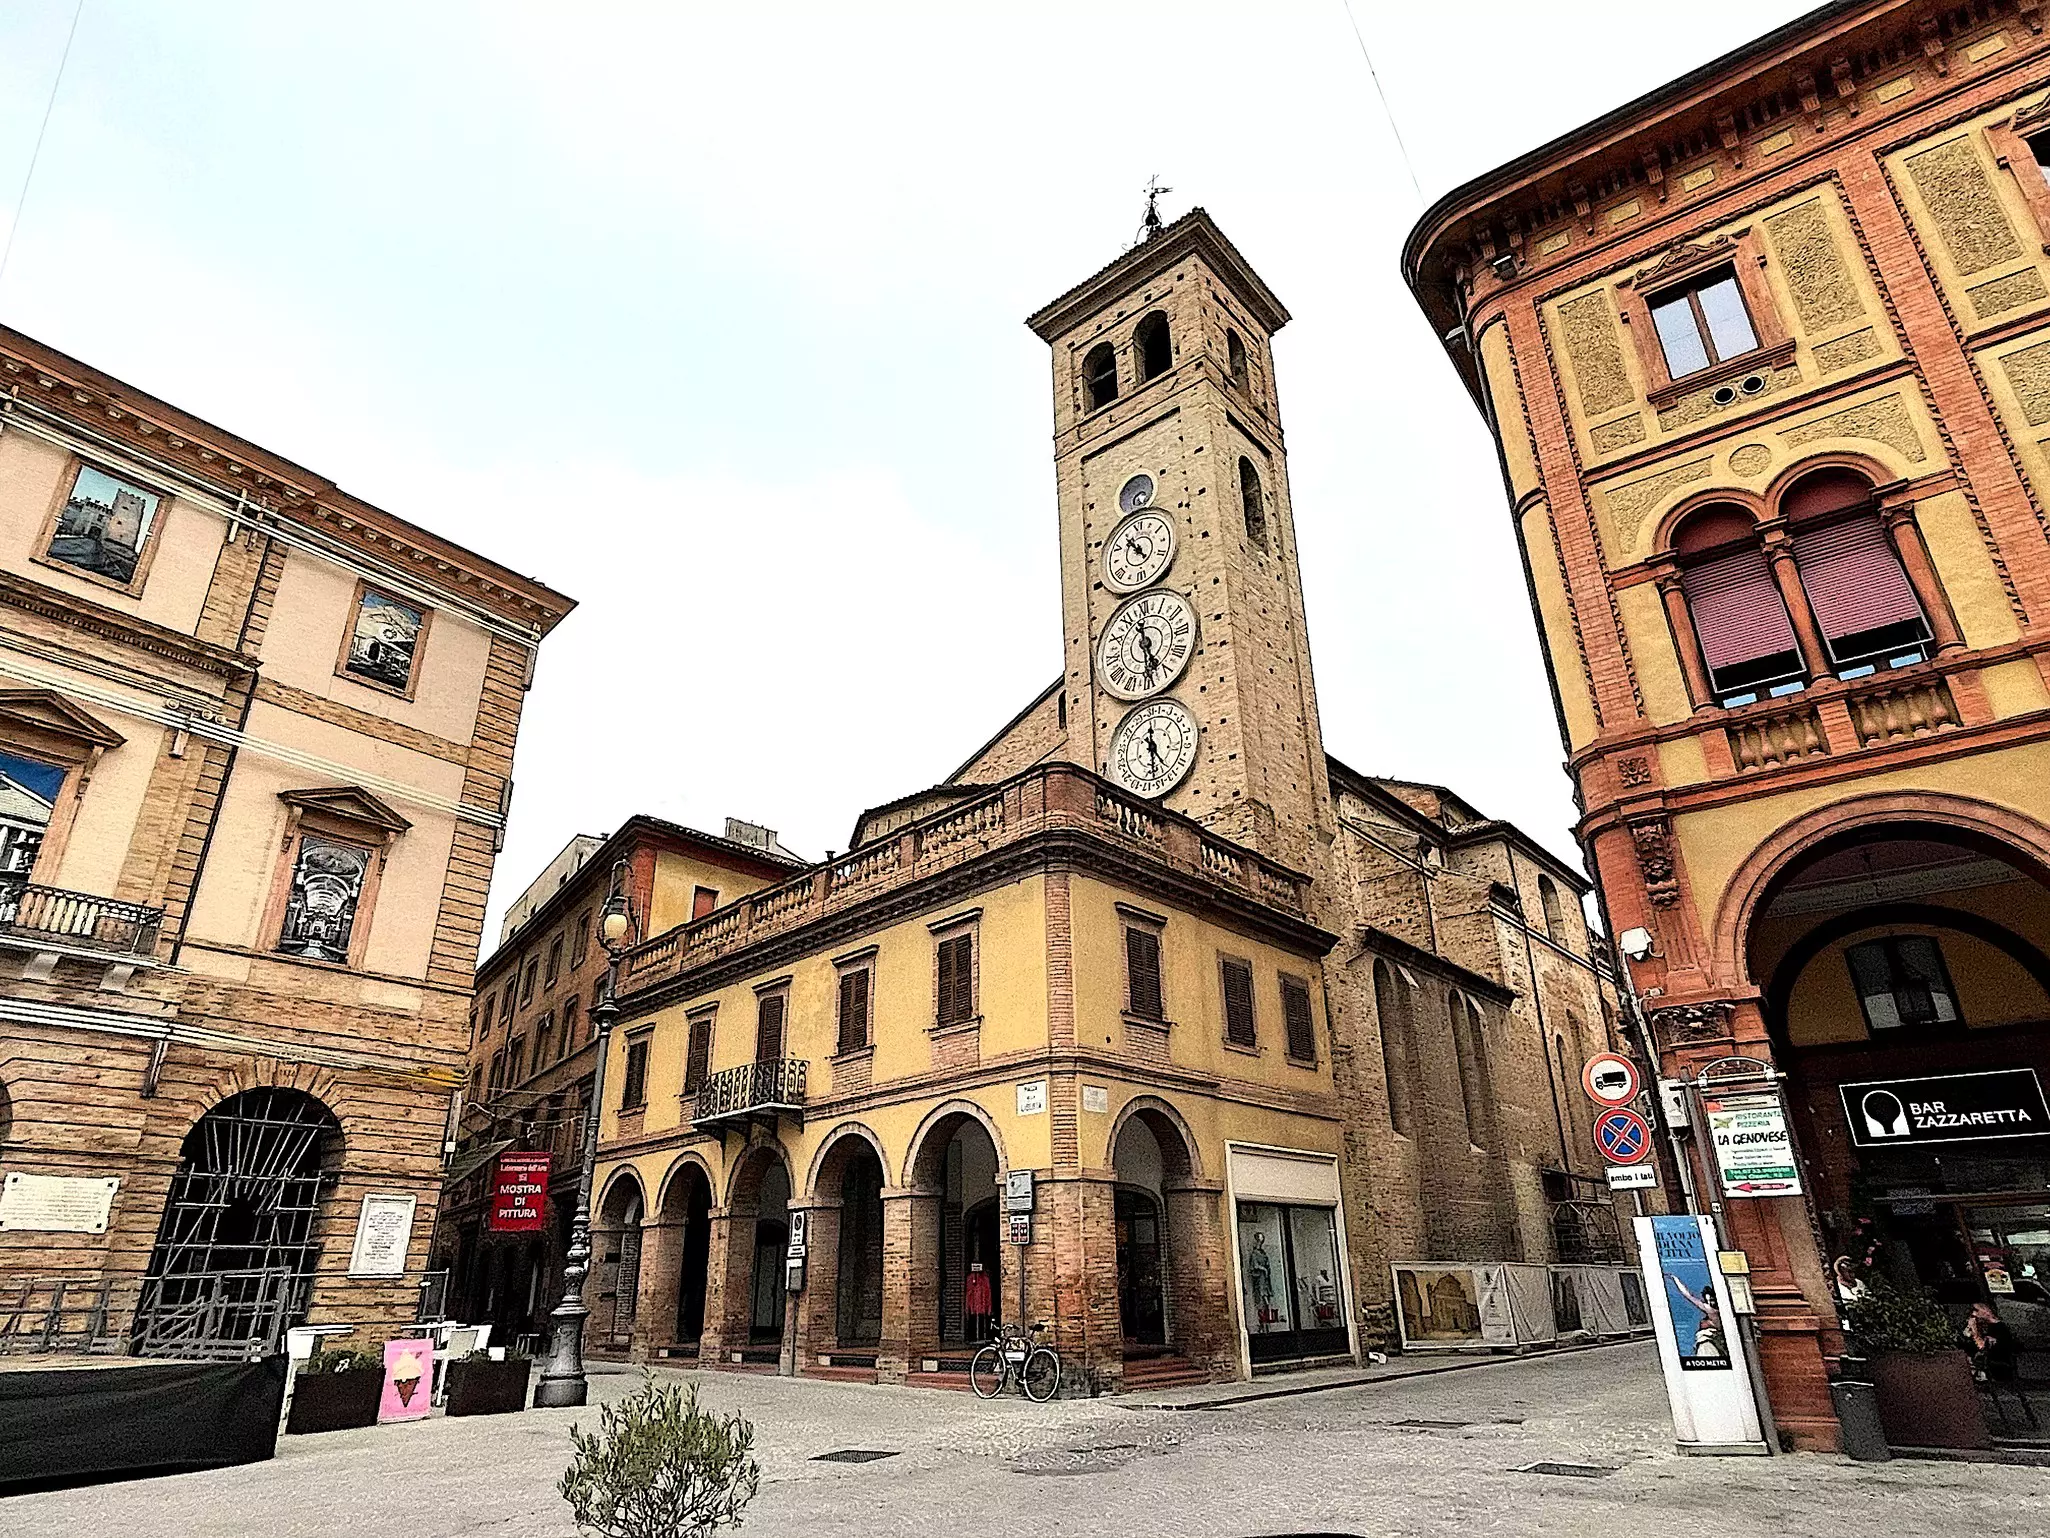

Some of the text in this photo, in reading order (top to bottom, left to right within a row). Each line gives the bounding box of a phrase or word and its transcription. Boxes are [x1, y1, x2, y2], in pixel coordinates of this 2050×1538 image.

[1909, 1101, 1947, 1115] BAR
[1914, 1109, 2032, 1128] ZAZZARETTA
[1718, 1130, 1788, 1145] LA GENOVESE
[500, 1185, 542, 1194] MOSTRA
[514, 1197, 526, 1206] DI
[498, 1208, 537, 1218] PITTURA
[1667, 1231, 1700, 1240] VOLTO
[1658, 1240, 1693, 1249] DI UNA
